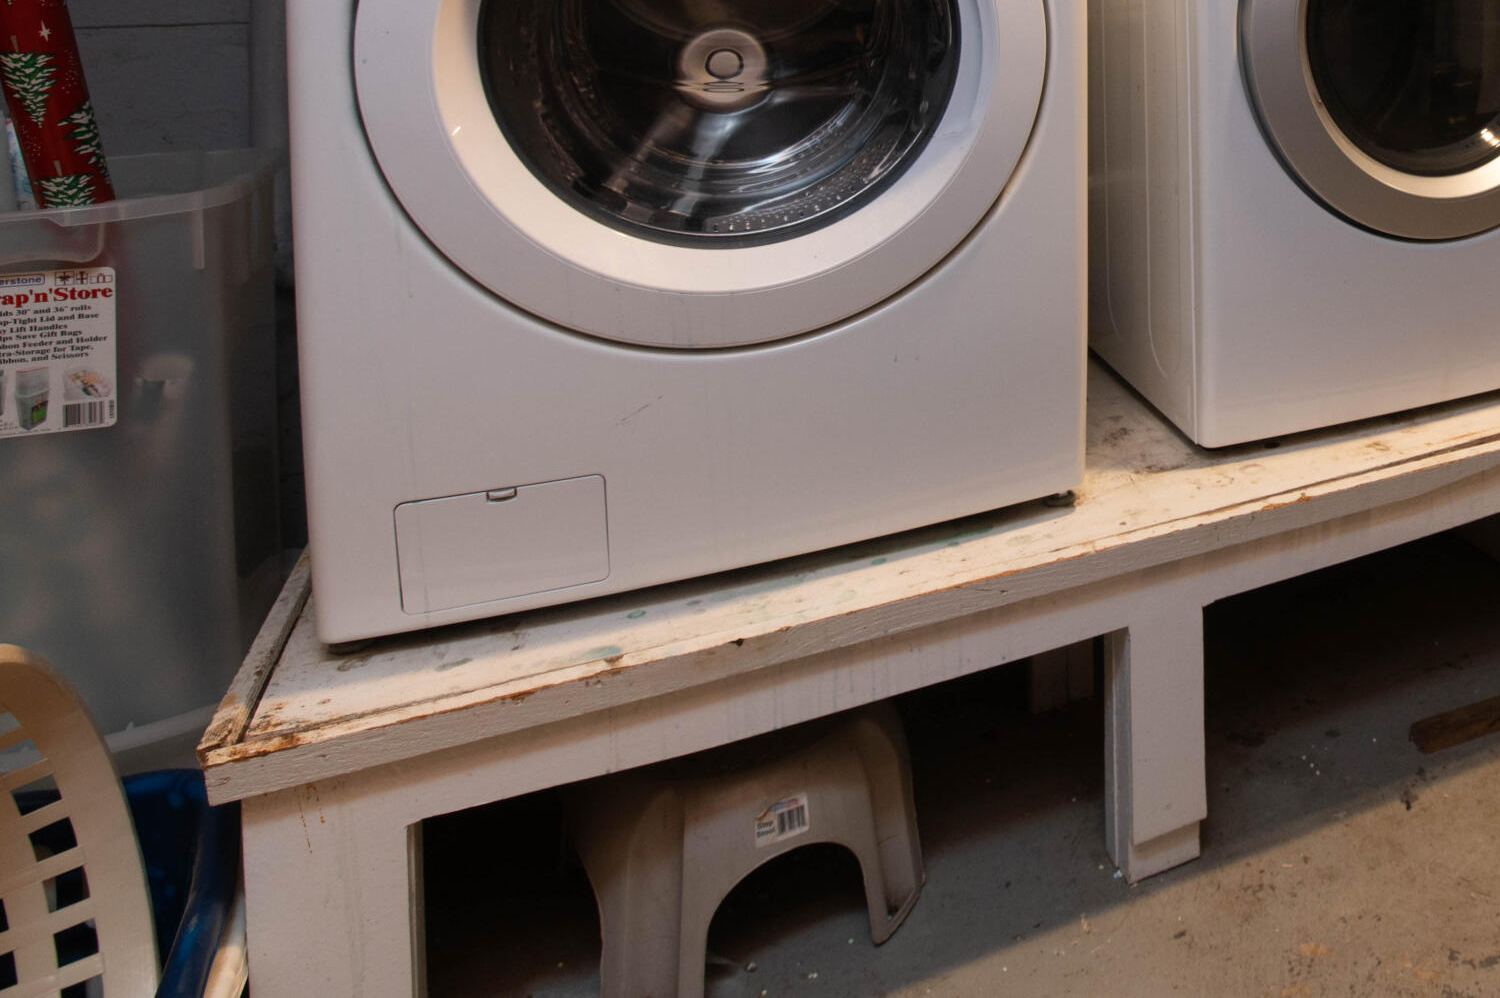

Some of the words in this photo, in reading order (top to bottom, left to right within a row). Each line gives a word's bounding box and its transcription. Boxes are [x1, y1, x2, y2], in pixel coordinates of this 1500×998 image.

[0, 287, 113, 308] ap'n'Store
[33, 306, 51, 315] and
[70, 304, 91, 312] rolls
[40, 315, 55, 323] Lid
[57, 313, 75, 321] and
[77, 312, 99, 320] Base
[9, 326, 26, 334] Lift
[29, 323, 68, 332] Handles
[15, 333, 37, 341] Save
[39, 330, 58, 339] Gift
[60, 329, 82, 338] Bags
[22, 340, 53, 348] Feeder
[56, 338, 74, 346] and
[76, 335, 108, 344] Holder
[53, 345, 67, 353] for
[31, 354, 49, 362] and
[51, 352, 89, 360] Scissors
